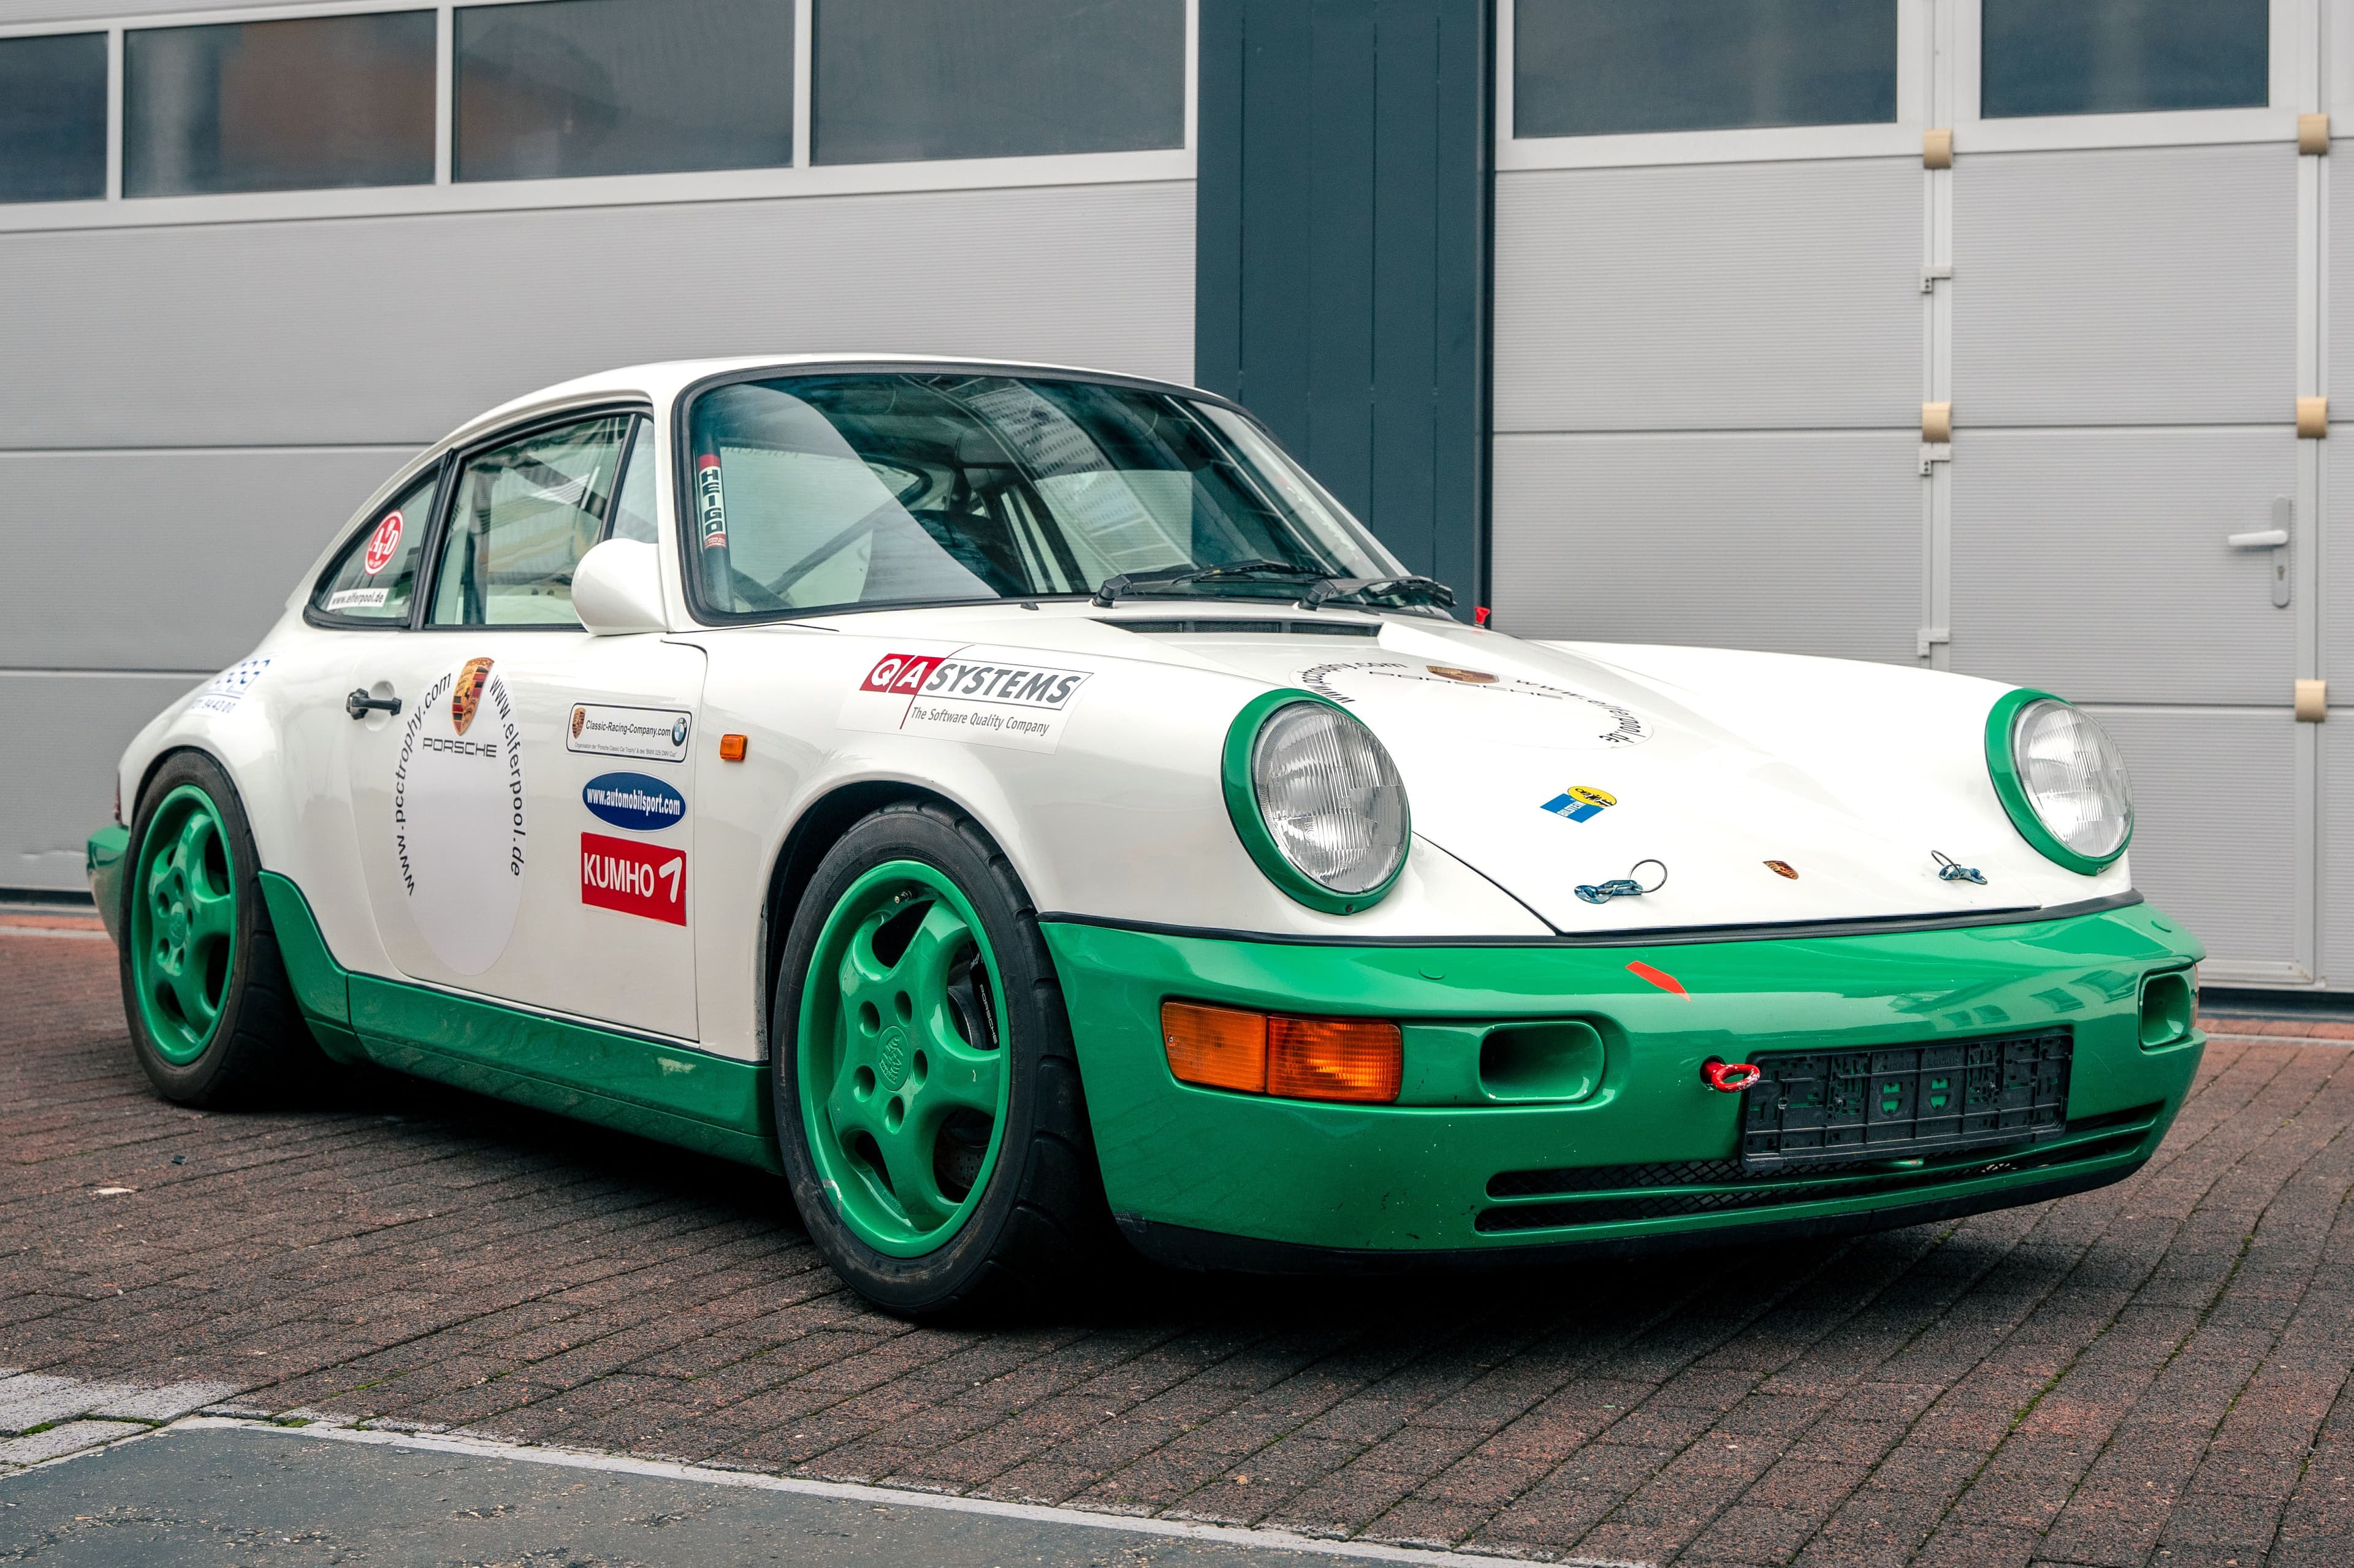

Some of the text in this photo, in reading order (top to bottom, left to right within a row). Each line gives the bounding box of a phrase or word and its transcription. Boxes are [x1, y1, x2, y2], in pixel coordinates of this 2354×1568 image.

[701, 470, 723, 536] HEIGO
[332, 592, 384, 606] www.elferpool.de
[871, 658, 1081, 704] QA SYSTEMS
[585, 720, 671, 737] Classic-Racing-Company.com
[910, 706, 1050, 736] The Software Quality Company
[422, 737, 497, 758] PORSCHE
[395, 672, 451, 896] www.pcctrophy.com
[489, 674, 526, 877] www.elferpool.de
[587, 788, 680, 816] www.automobilsport.com
[1556, 800, 1587, 817] BILSTEIN
[584, 852, 655, 897] KUMHO
